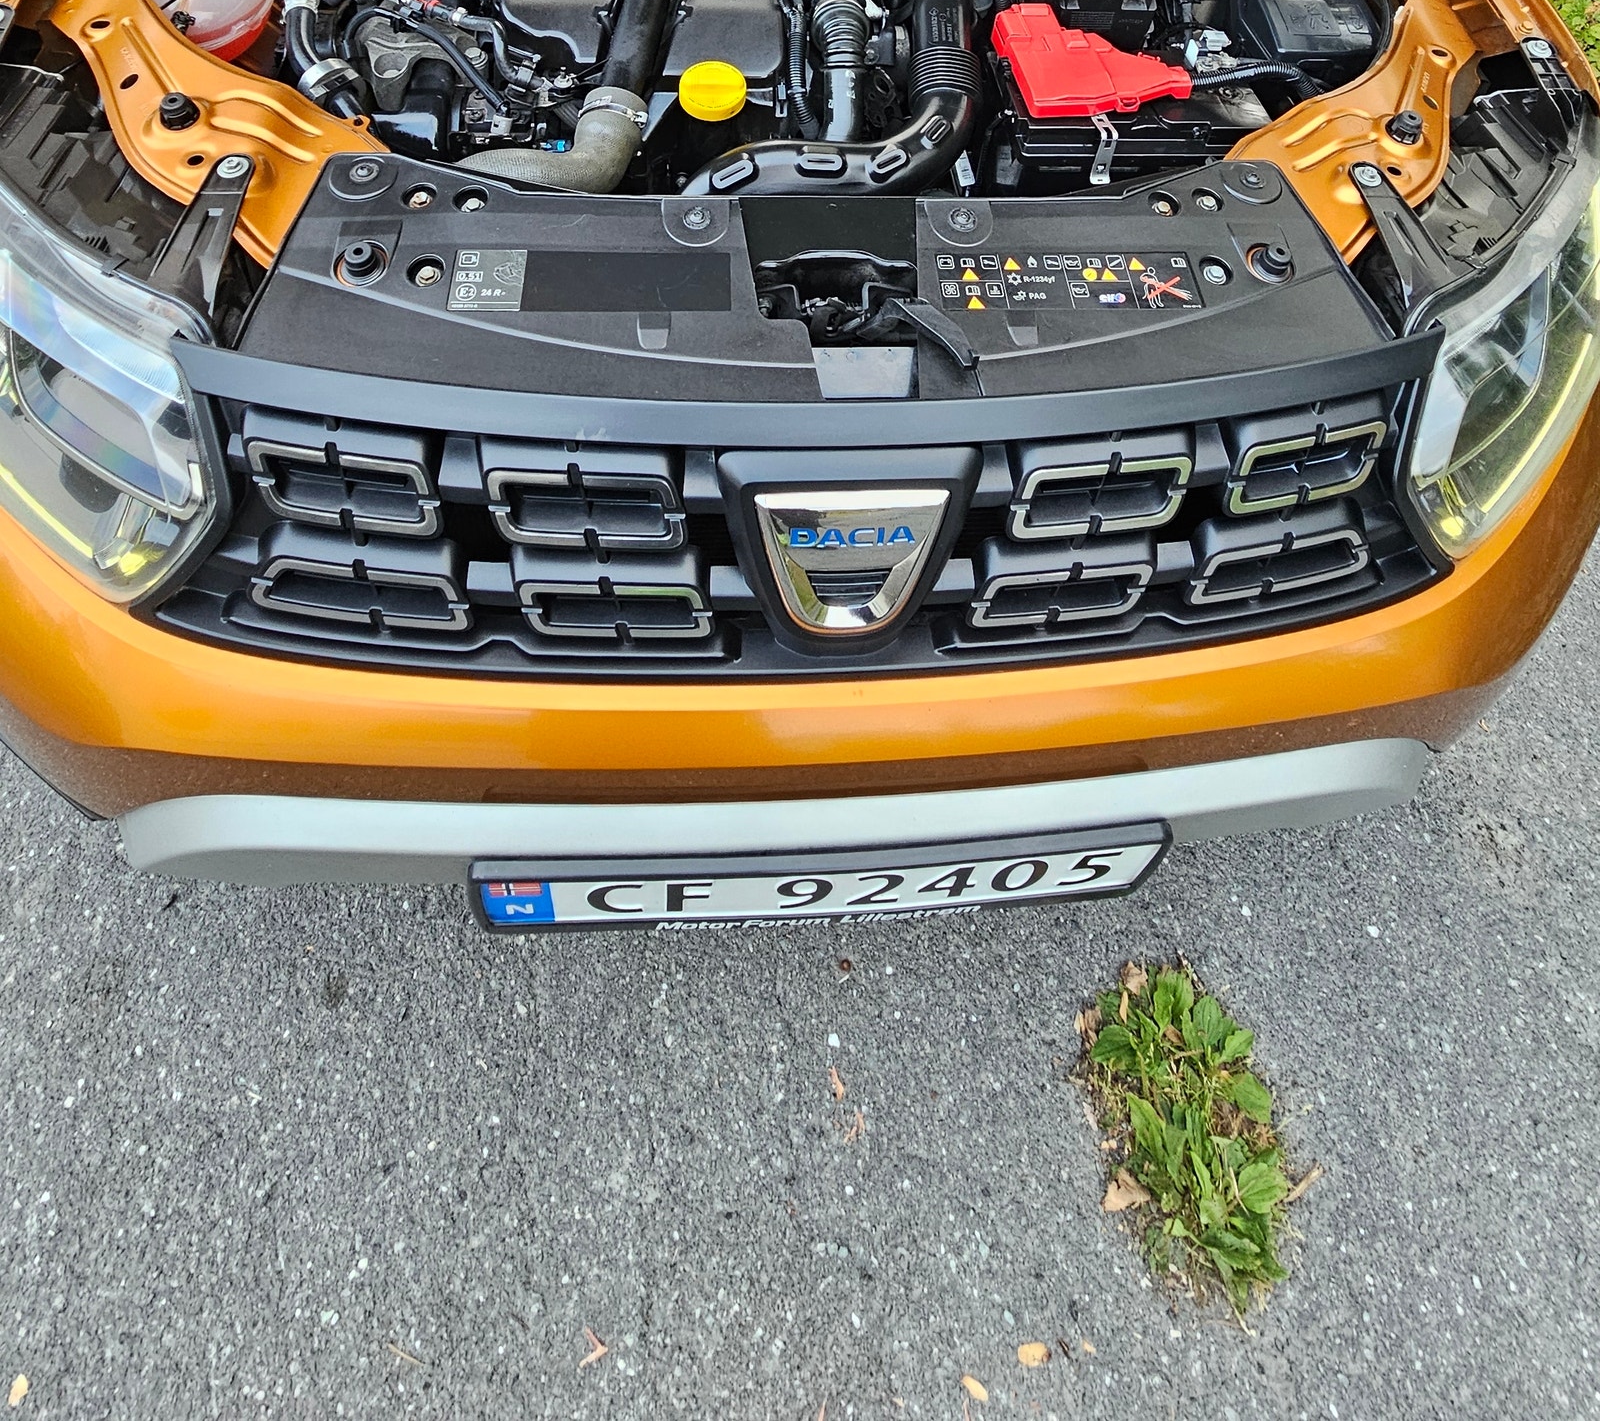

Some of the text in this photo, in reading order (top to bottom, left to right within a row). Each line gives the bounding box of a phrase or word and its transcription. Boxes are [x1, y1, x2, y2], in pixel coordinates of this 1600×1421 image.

[480, 288, 492, 297] 24
[1028, 292, 1047, 300] PAG
[789, 525, 916, 549] DACIA
[585, 850, 1125, 913] CF 92405
[505, 903, 535, 915] N
